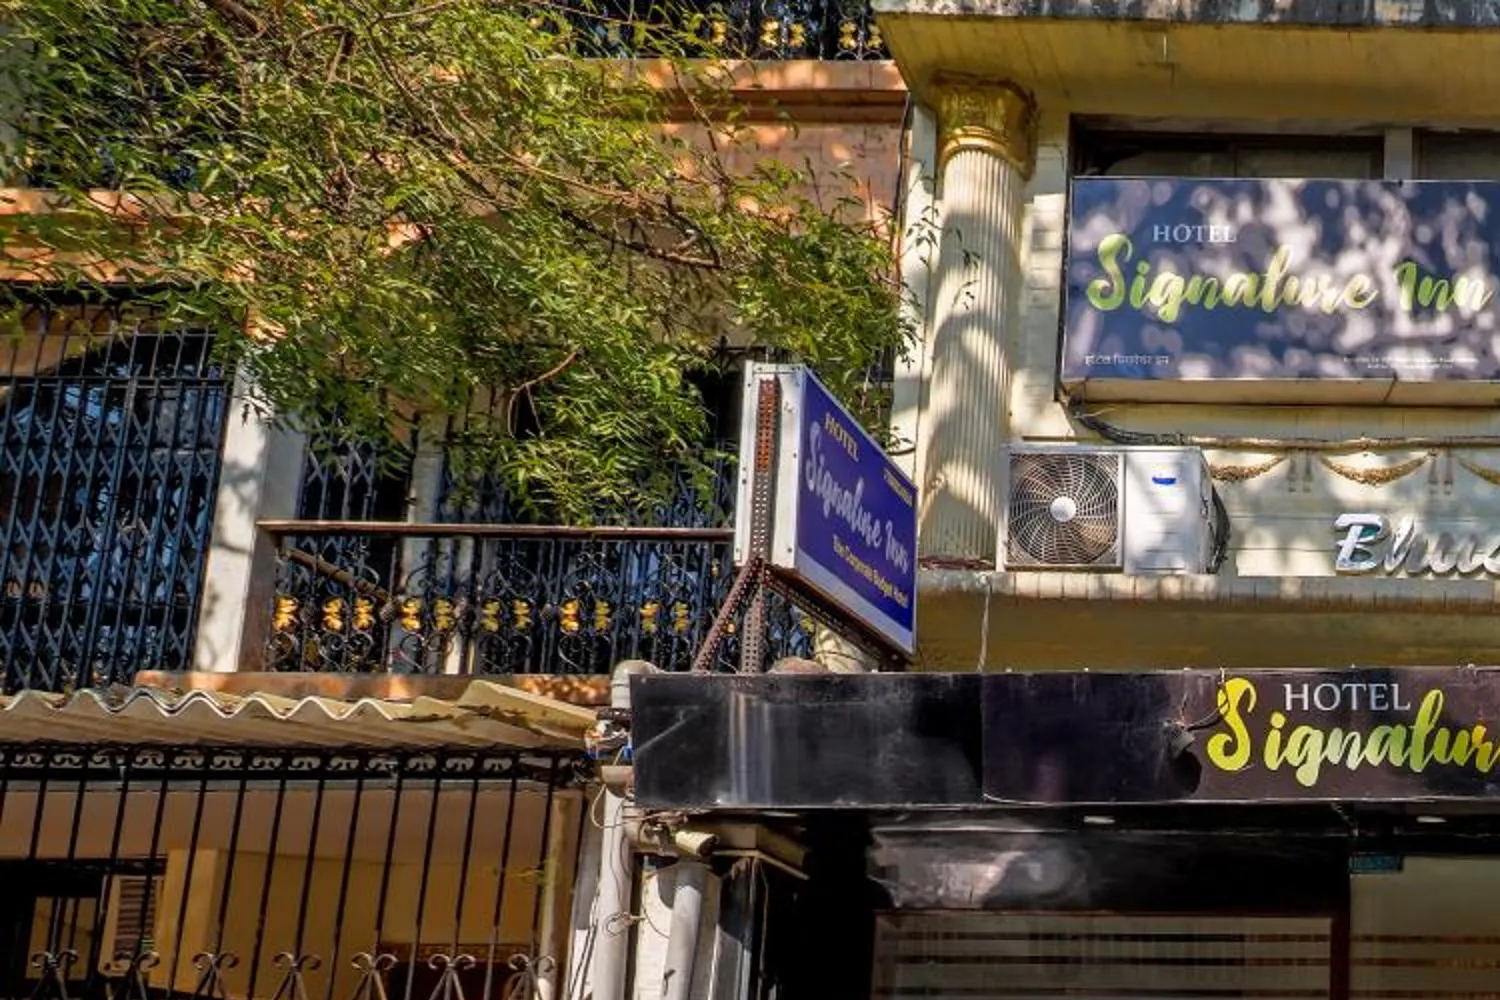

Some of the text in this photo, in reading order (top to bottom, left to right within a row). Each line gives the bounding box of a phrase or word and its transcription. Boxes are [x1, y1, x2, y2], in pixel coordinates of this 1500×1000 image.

[1152, 224, 1237, 243] HOTEL
[1086, 233, 1494, 322] Signature Inn
[823, 412, 858, 461] HOTEL
[1283, 683, 1411, 711] HOTEL
